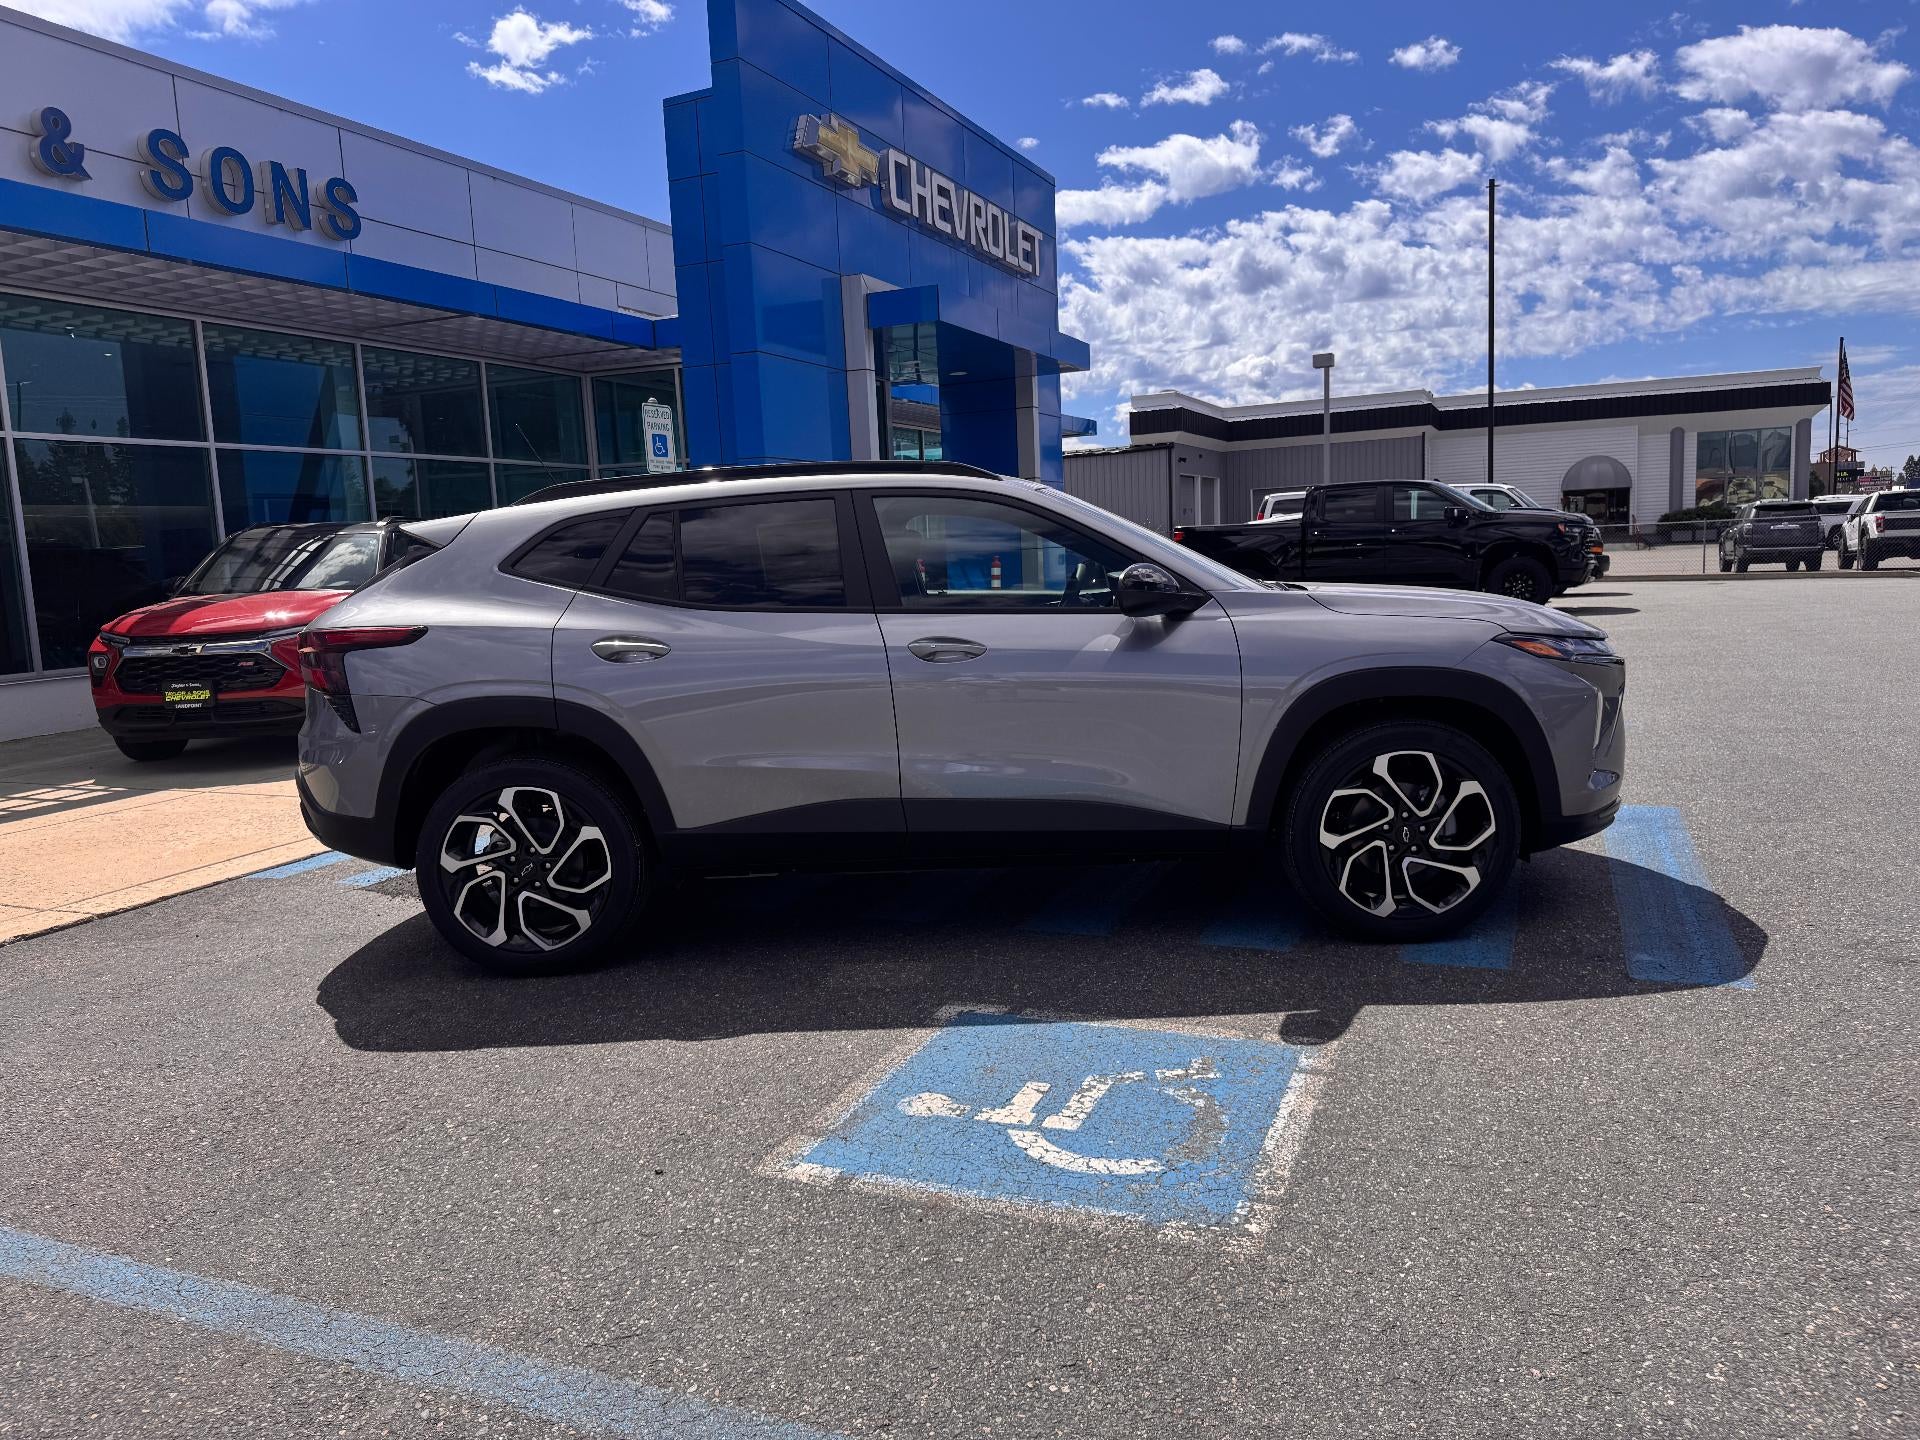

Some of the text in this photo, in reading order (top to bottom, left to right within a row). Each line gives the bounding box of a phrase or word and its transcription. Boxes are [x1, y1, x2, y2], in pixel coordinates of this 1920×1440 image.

[31, 106, 362, 241] & SONS
[881, 148, 1043, 277] CHEVROLET
[645, 408, 670, 420] RESERVED
[646, 421, 670, 432] PARKING
[165, 694, 211, 702] CHEVROLET
